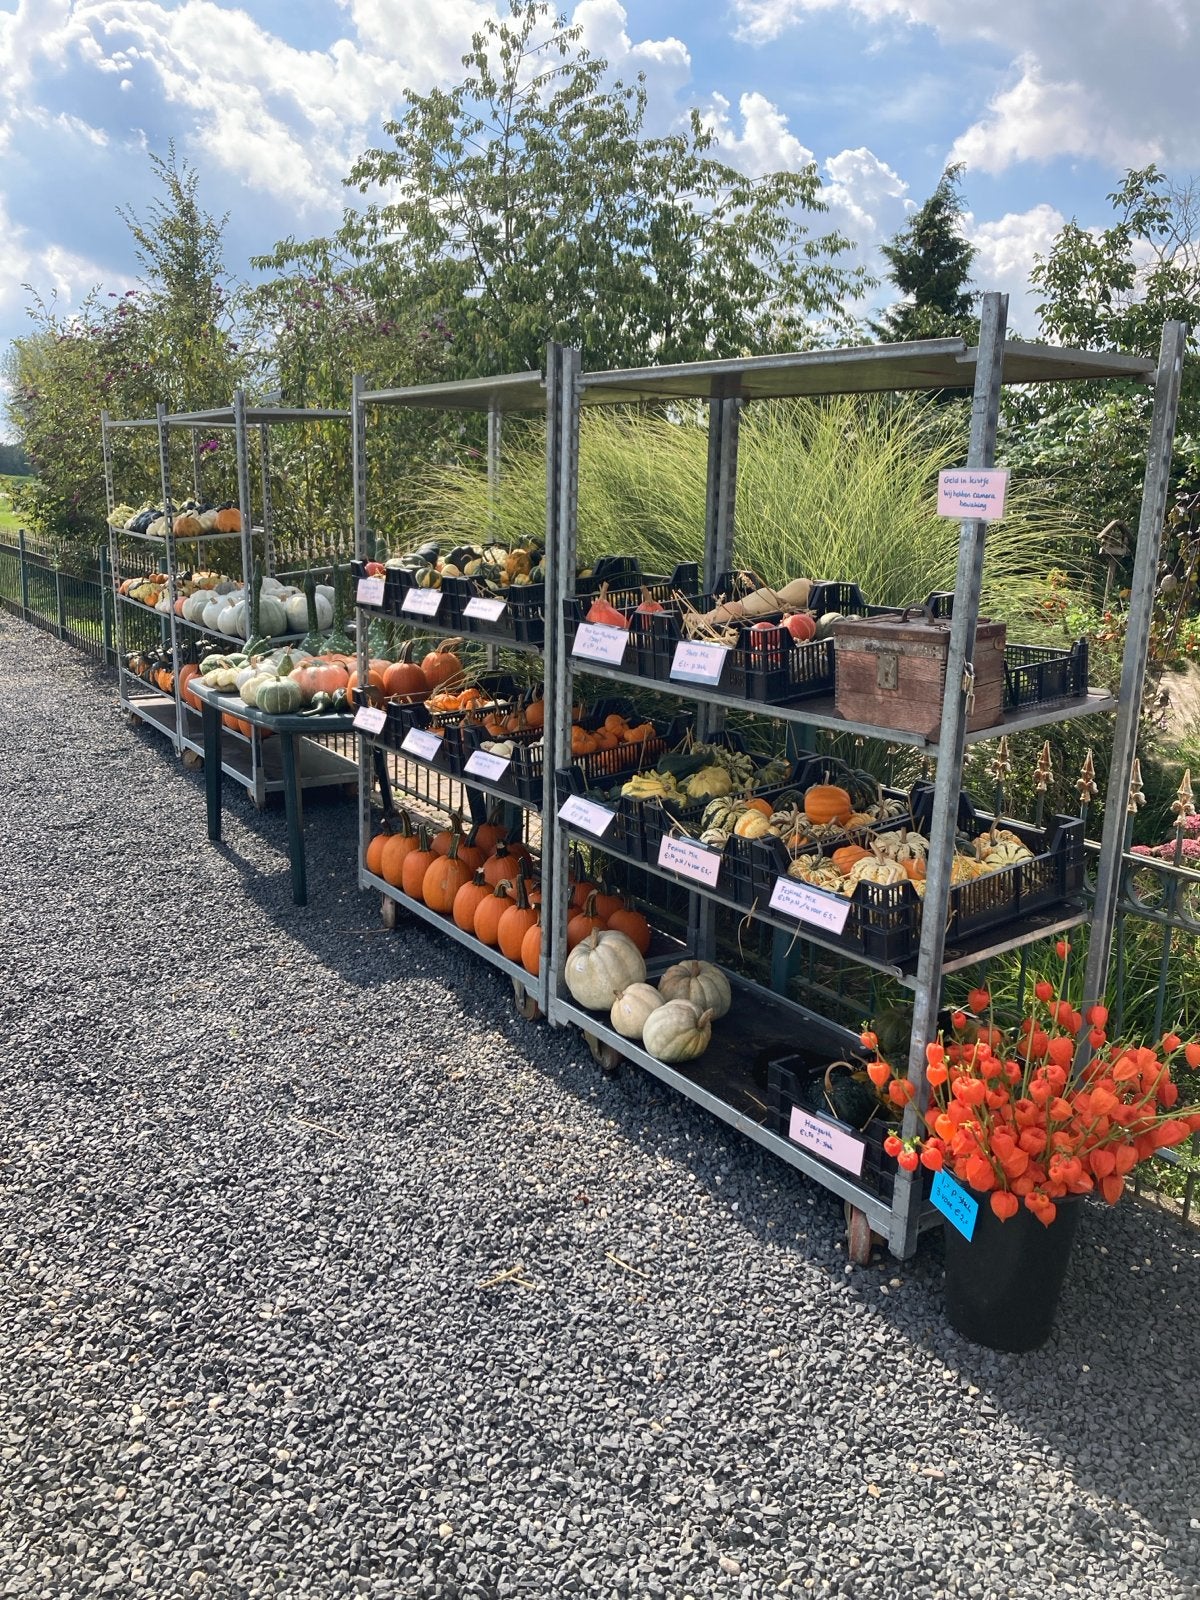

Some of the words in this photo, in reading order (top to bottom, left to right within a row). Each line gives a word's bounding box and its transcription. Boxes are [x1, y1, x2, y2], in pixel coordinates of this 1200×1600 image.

[943, 475, 960, 484] Geld
[969, 475, 990, 488] kistje
[780, 885, 802, 899] Festival
[805, 894, 817, 904] Mix
